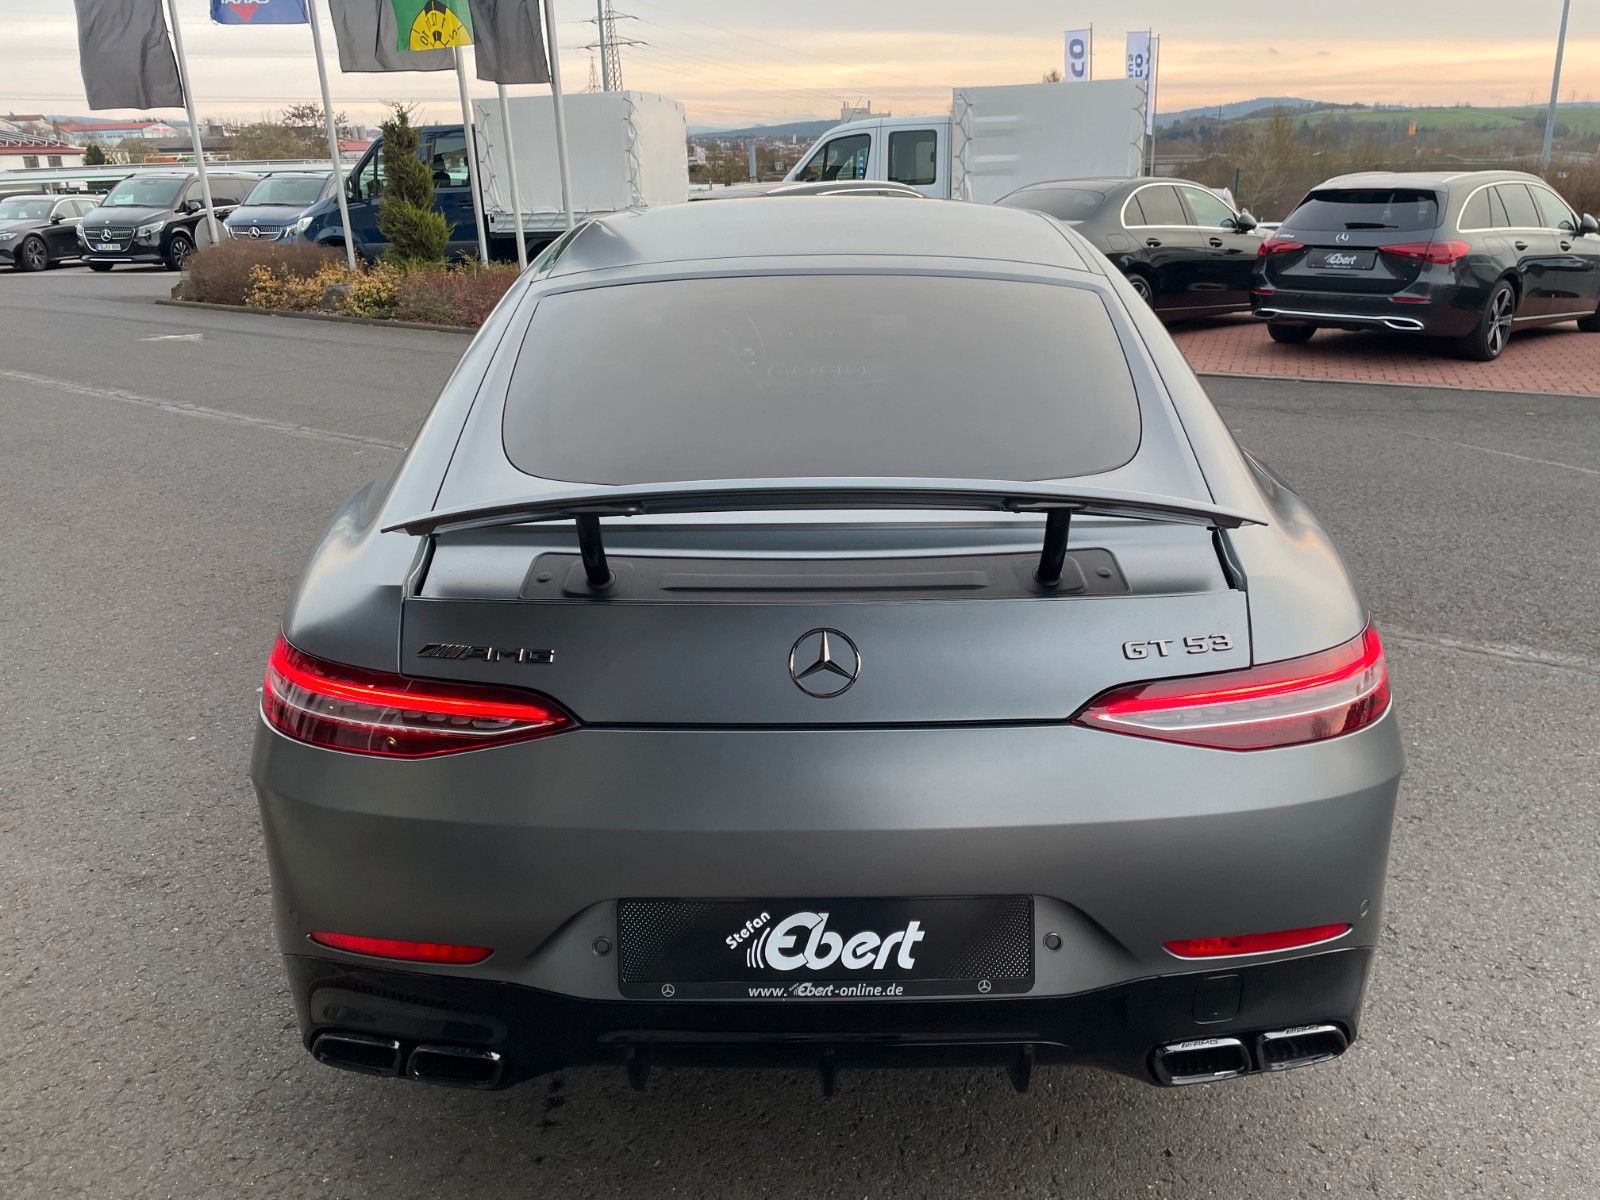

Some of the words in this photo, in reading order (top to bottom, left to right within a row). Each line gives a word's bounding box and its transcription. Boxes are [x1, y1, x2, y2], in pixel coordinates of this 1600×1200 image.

[1122, 639, 1173, 660] GT
[1183, 633, 1234, 655] 53
[725, 910, 771, 950] Stefan
[763, 911, 926, 971] Ebert
